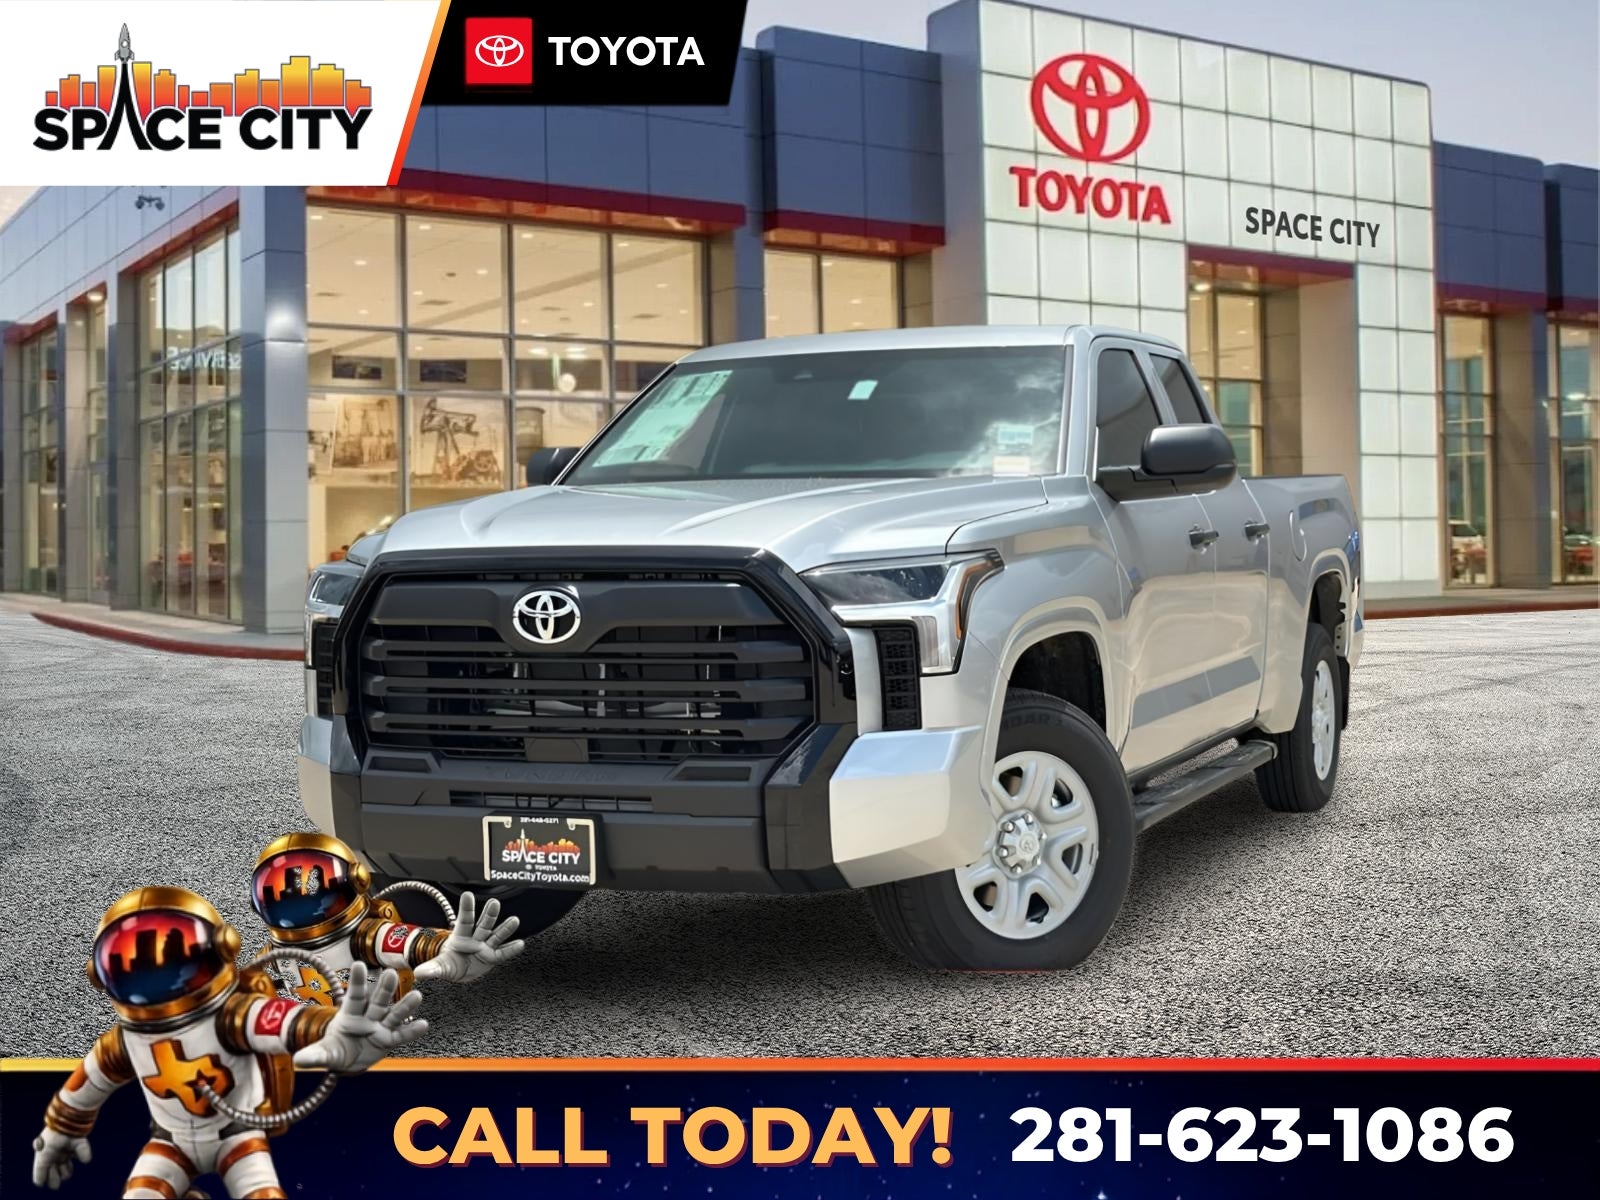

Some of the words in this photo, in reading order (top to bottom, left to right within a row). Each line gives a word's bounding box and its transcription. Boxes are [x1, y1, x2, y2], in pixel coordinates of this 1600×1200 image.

[1009, 166, 1171, 225] TOYOTA
[1245, 206, 1323, 242] SPACE
[1329, 217, 1381, 248] CITY
[502, 848, 546, 863] SPACE
[548, 851, 581, 865] CITY
[491, 870, 590, 882] SpaceCityToyota.com
